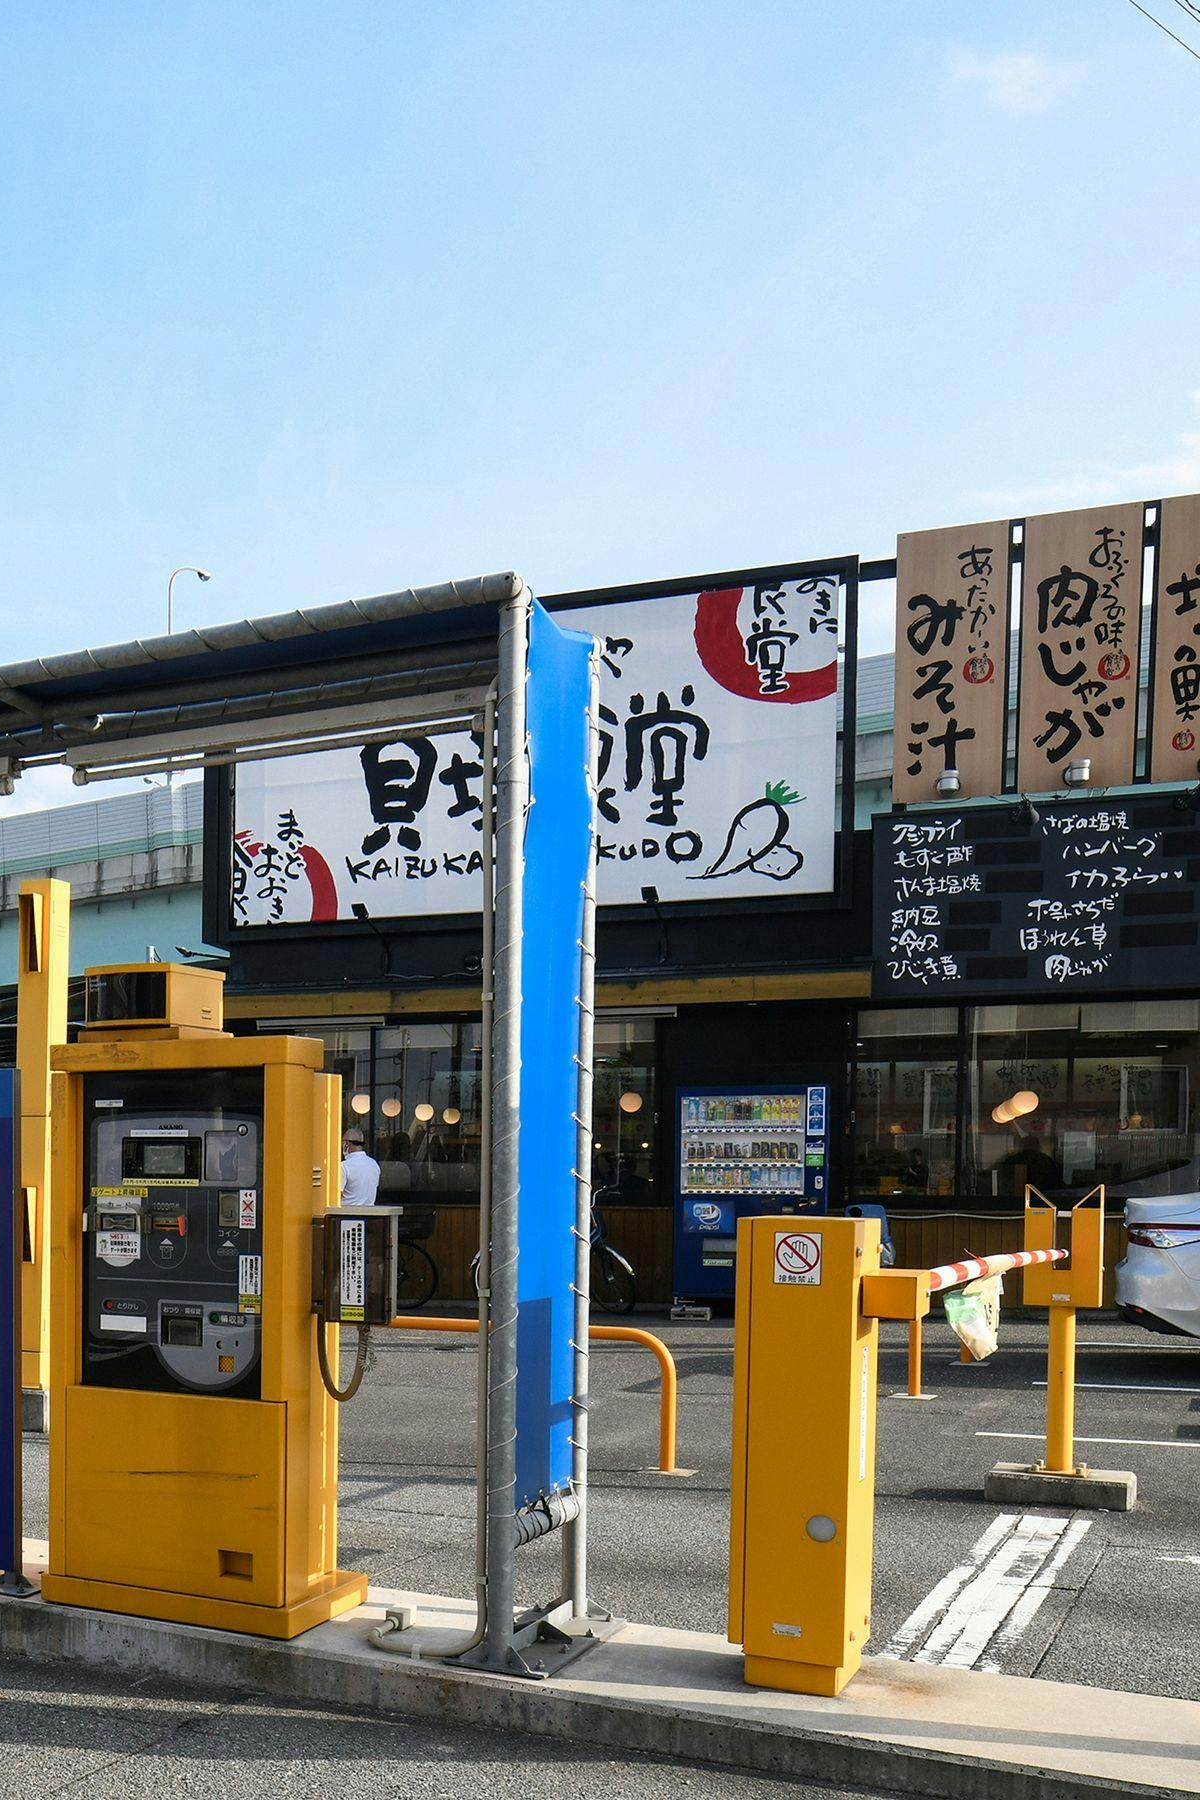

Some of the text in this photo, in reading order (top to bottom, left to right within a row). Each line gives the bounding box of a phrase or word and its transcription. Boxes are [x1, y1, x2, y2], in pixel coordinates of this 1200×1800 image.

[1032, 565, 1126, 764] 肉じゃが
[907, 593, 976, 776] みそ汁
[1042, 810, 1130, 836] さばの塩焼
[1062, 832, 1164, 859] ハンバーグ
[346, 851, 496, 883] KAIZUKA
[894, 846, 974, 875] もずく酢
[894, 874, 983, 902] さんま塩焼
[891, 905, 941, 931] 納豆
[890, 928, 939, 957] 冷奴
[1019, 923, 1108, 952] ほうれん草
[1044, 953, 1113, 983] 肉じゃが
[778, 1274, 816, 1284] 接触禁止
